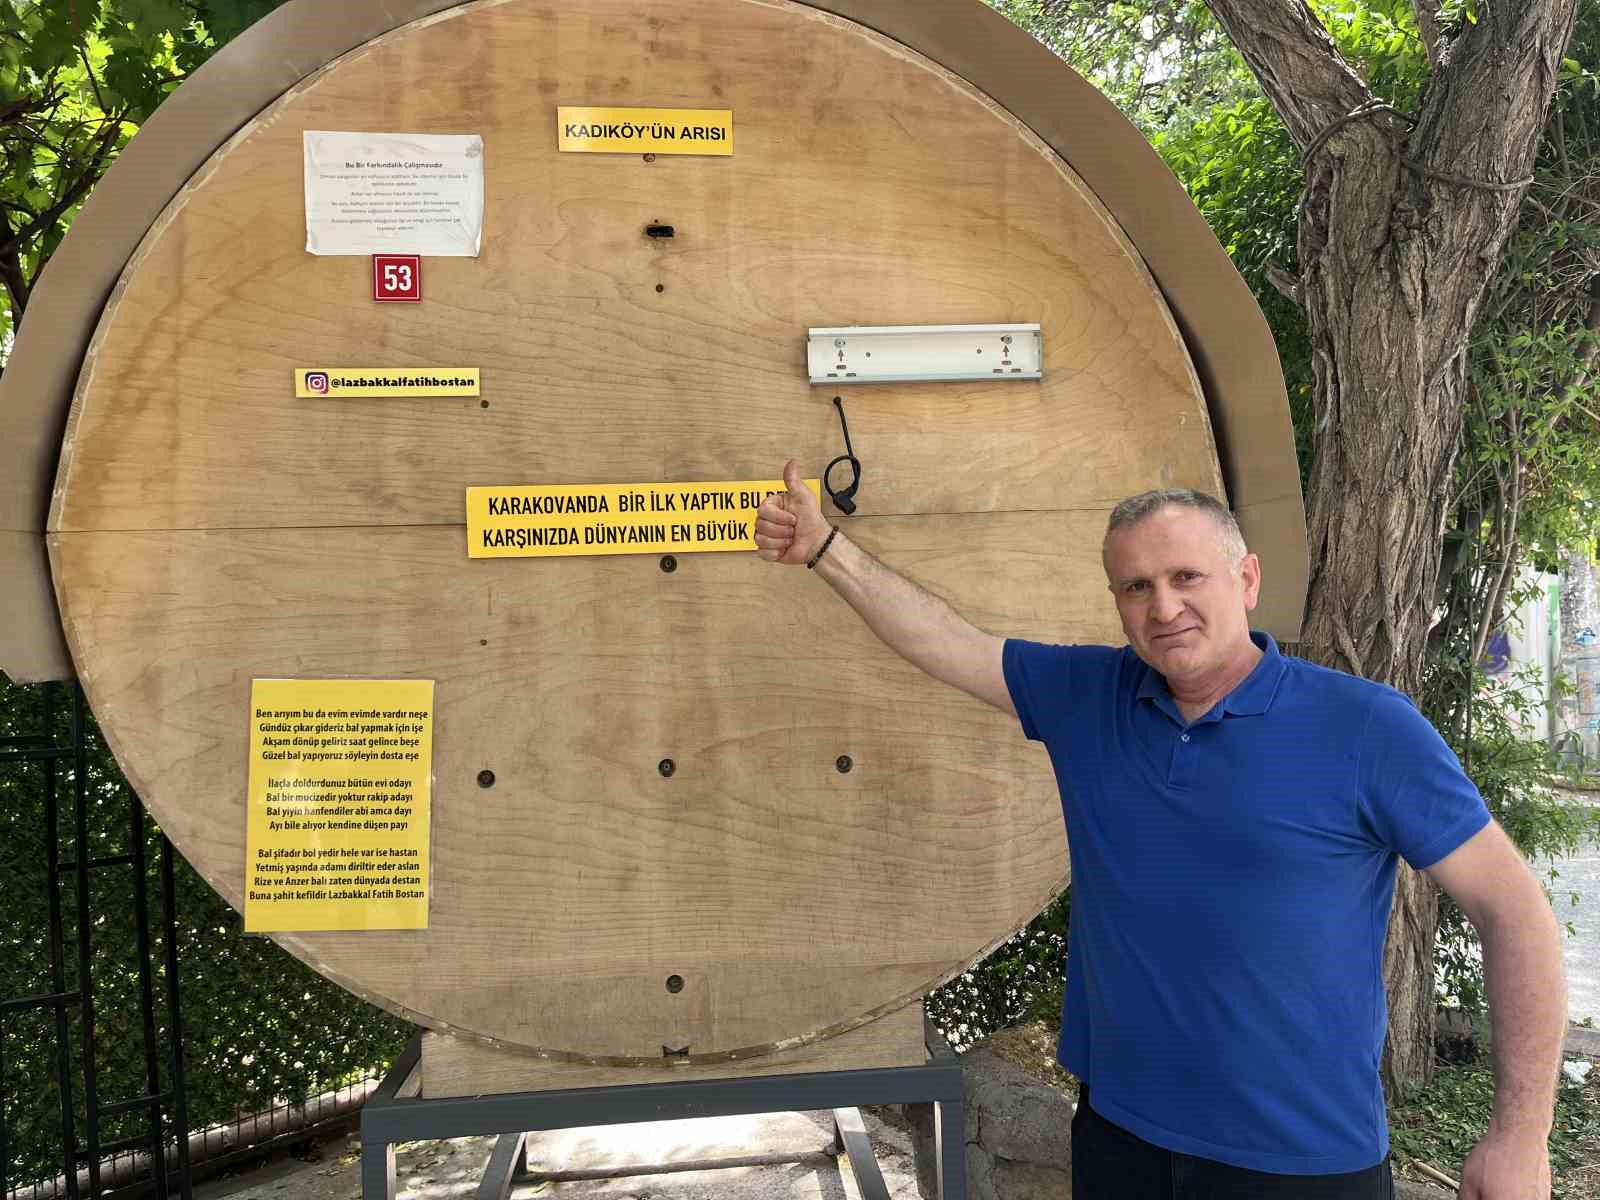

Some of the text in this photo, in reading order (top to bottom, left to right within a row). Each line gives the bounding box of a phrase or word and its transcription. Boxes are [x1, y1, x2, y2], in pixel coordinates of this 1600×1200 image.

[680, 127, 726, 140] ARISI
[384, 265, 412, 291] 53
[331, 377, 475, 387] @lazbakkalfatihbostan
[488, 495, 609, 515] KARAKOVANDA
[620, 492, 644, 512] BİR
[651, 491, 675, 511] İLK
[681, 492, 734, 510] YAPTIK
[740, 491, 760, 508] BU
[483, 521, 748, 548] KARŞINIZDA DÜNYANIN EN BÜYÜK
[256, 709, 428, 720] Ben arıyım bu da evim evimde vardır neşe
[259, 723, 423, 734] Gündüz çıkar gideriz bal yapmak için işe
[263, 737, 291, 747] Akşam
[292, 737, 319, 747] dönüp
[322, 737, 347, 748] geliriz
[368, 737, 399, 748] gelince
[401, 737, 419, 747] beşe
[262, 751, 419, 761] Güzel bal yapıyoruz söyleyin dosta eşe
[268, 778, 412, 789] İlaçla doldurdunuz bütün evi odayı
[267, 792, 412, 803] Bal bir mucizedir yoktur rakip adayı
[267, 807, 280, 816] Bal
[355, 806, 369, 815] abi
[394, 806, 412, 816] dayı
[270, 820, 408, 831] Ayı bile alıyor kendine düşen payı
[258, 849, 272, 858] Bal
[274, 849, 300, 859] şifadır
[303, 848, 316, 857] bol
[318, 848, 339, 859] yedir
[341, 848, 359, 857] hele
[376, 848, 387, 857] ise
[389, 848, 417, 857] hastan
[256, 862, 419, 873] Yetmiş yaşında adamı diriltir eder aslan
[255, 877, 272, 886] Rize
[285, 877, 309, 885] Anzer
[312, 876, 327, 885] balı
[329, 877, 353, 885] zaten
[355, 876, 390, 886] dünyada
[392, 875, 420, 884] destan
[250, 888, 424, 902] Buna şahit kefildir Lazbakkal Fatih Bostan
